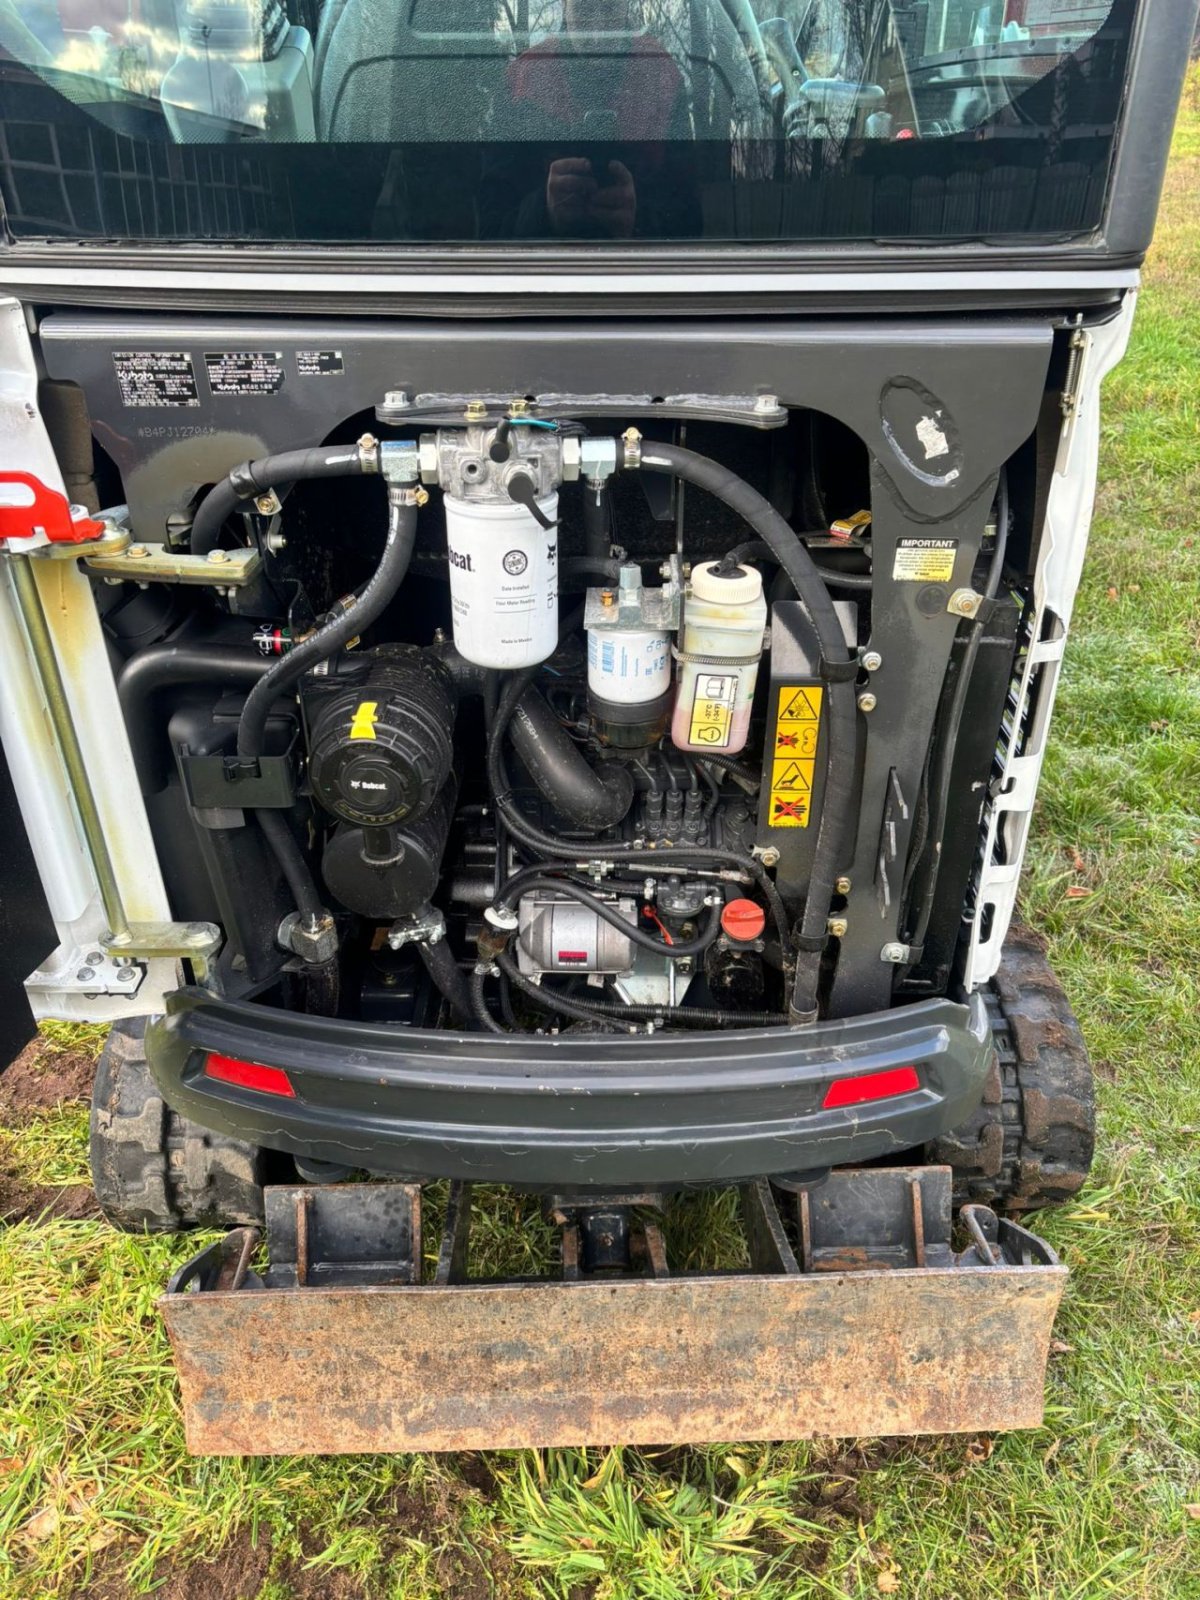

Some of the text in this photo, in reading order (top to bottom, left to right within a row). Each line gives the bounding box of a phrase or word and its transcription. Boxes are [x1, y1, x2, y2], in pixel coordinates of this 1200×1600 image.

[901, 539, 954, 548] IMPORTANT
[449, 544, 473, 572] bcat
[362, 782, 386, 790] Bobcat
